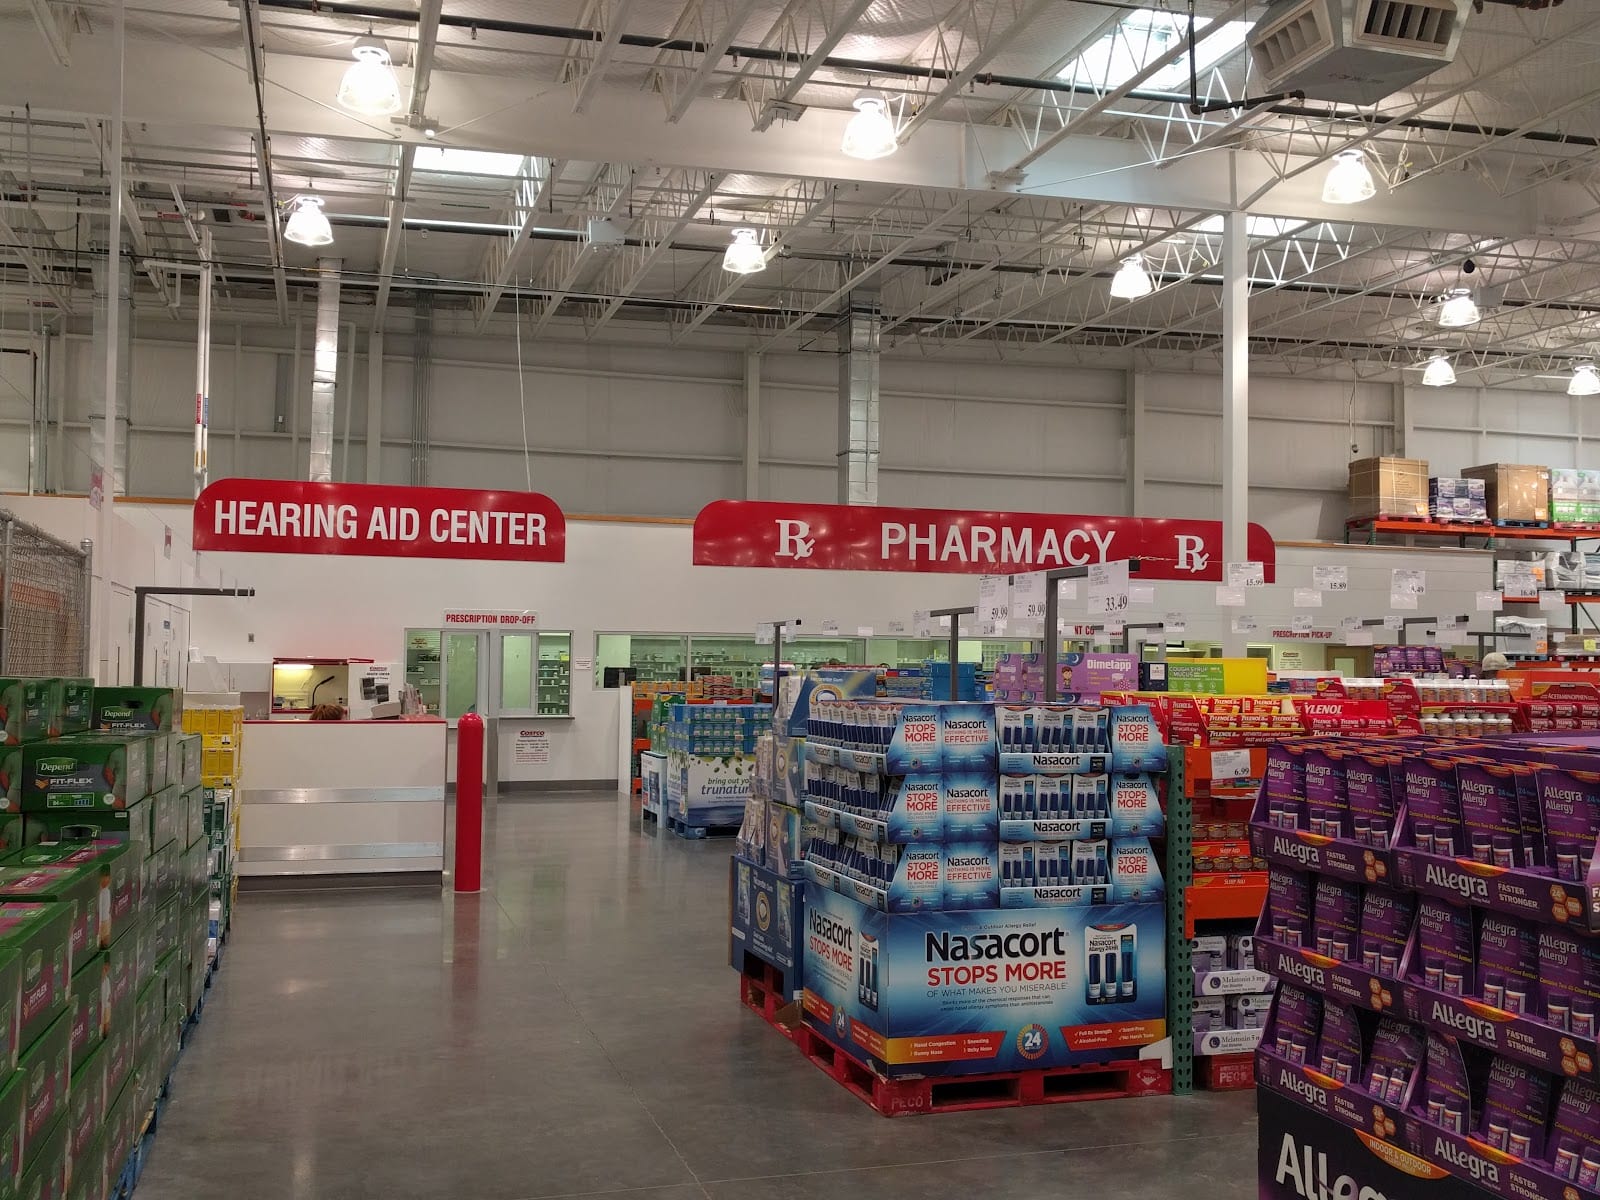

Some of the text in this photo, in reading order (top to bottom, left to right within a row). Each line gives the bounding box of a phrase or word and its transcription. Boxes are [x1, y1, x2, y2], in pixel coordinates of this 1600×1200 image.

[214, 499, 547, 546] HEARING AID CENTER
[880, 521, 1115, 566] PHARMACY
[1105, 595, 1128, 611] 33.49
[991, 606, 1009, 620] 59.99
[1027, 603, 1046, 617] 59.99
[446, 613, 536, 625] PRESCRIPTION DROP-OFF
[1311, 631, 1333, 639] PICK-UP
[1087, 659, 1132, 671] Dimetapp
[104, 709, 131, 719] Depend
[903, 714, 937, 722] Nasacort
[904, 724, 936, 733] STOPS
[944, 720, 986, 729] Nasacort
[1118, 724, 1149, 732] STOPS
[905, 732, 936, 742] MORE
[944, 735, 989, 743] EFFECTIVE
[1118, 732, 1149, 741] MORE
[1033, 755, 1080, 766] Nasacort
[1268, 758, 1291, 771] Allegra
[40, 762, 75, 772] Depend
[1234, 767, 1250, 776] 6.99
[1305, 763, 1331, 776] Allegra
[1268, 769, 1285, 780] Allergy
[1306, 774, 1325, 786] Allergy
[708, 778, 726, 786] bring
[905, 783, 938, 791] Nasacort
[1116, 781, 1147, 789] Nasacort
[1461, 779, 1494, 795] Allegra
[701, 785, 750, 795] trunatur
[946, 789, 988, 799] Nasacort
[1117, 790, 1147, 799] STOPS
[1544, 786, 1583, 802] Allegra
[906, 793, 938, 802] STOPS
[1462, 793, 1487, 806] Allergy
[906, 801, 938, 811] MORE
[946, 803, 991, 812] EFFECTIVE
[1117, 799, 1147, 808] MORE
[1545, 800, 1574, 814] Allergy
[1033, 822, 1081, 832] Nasacort
[1116, 847, 1148, 855] Nasacort
[1273, 836, 1319, 864] Allegra
[1326, 850, 1347, 859] FASTER.
[906, 852, 940, 860] Nasacort
[947, 857, 989, 866] Nasacort
[1117, 856, 1147, 865] STOPS
[907, 862, 938, 871] STOPS
[1117, 865, 1147, 874] MORE
[907, 871, 939, 880] MORE
[947, 872, 992, 881] EFFECTIVE
[1425, 863, 1488, 897] Allegra
[1034, 888, 1082, 899] Nasacort
[1498, 883, 1527, 896] FASTER.
[810, 907, 853, 952] Nasacort
[926, 927, 1065, 962] Nasacort
[1090, 939, 1117, 947] Nasacort
[1539, 934, 1578, 954] Allegra
[809, 935, 830, 960] STOPS
[832, 947, 853, 972] MORE
[1539, 948, 1568, 966] Allergy
[927, 961, 1067, 986] STOPS MORE
[1278, 953, 1325, 985] Allegra
[1222, 975, 1251, 983] Melatonin
[1331, 974, 1353, 987] FASTER.
[926, 990, 938, 998] OF
[941, 988, 966, 997] WHAT
[968, 987, 997, 996] MAKES
[1000, 985, 1018, 994] YOU
[967, 1004, 984, 1012] allergy
[985, 1002, 1008, 1010] symptoms
[1432, 1001, 1496, 1041] Allegra
[1024, 1031, 1042, 1047] 24
[1221, 1034, 1250, 1043] Melatonin
[1506, 1028, 1537, 1045] FASTER.
[929, 1040, 956, 1048] Congestion
[1280, 1069, 1327, 1105] Allegra
[891, 1096, 923, 1110] PECO
[1334, 1096, 1355, 1109] FASTER.
[1369, 1138, 1393, 1157] INDOOR
[1400, 1154, 1432, 1176] OUTDOOR
[1434, 1136, 1499, 1183] Allegra
[1509, 1172, 1539, 1191] FASTER.
